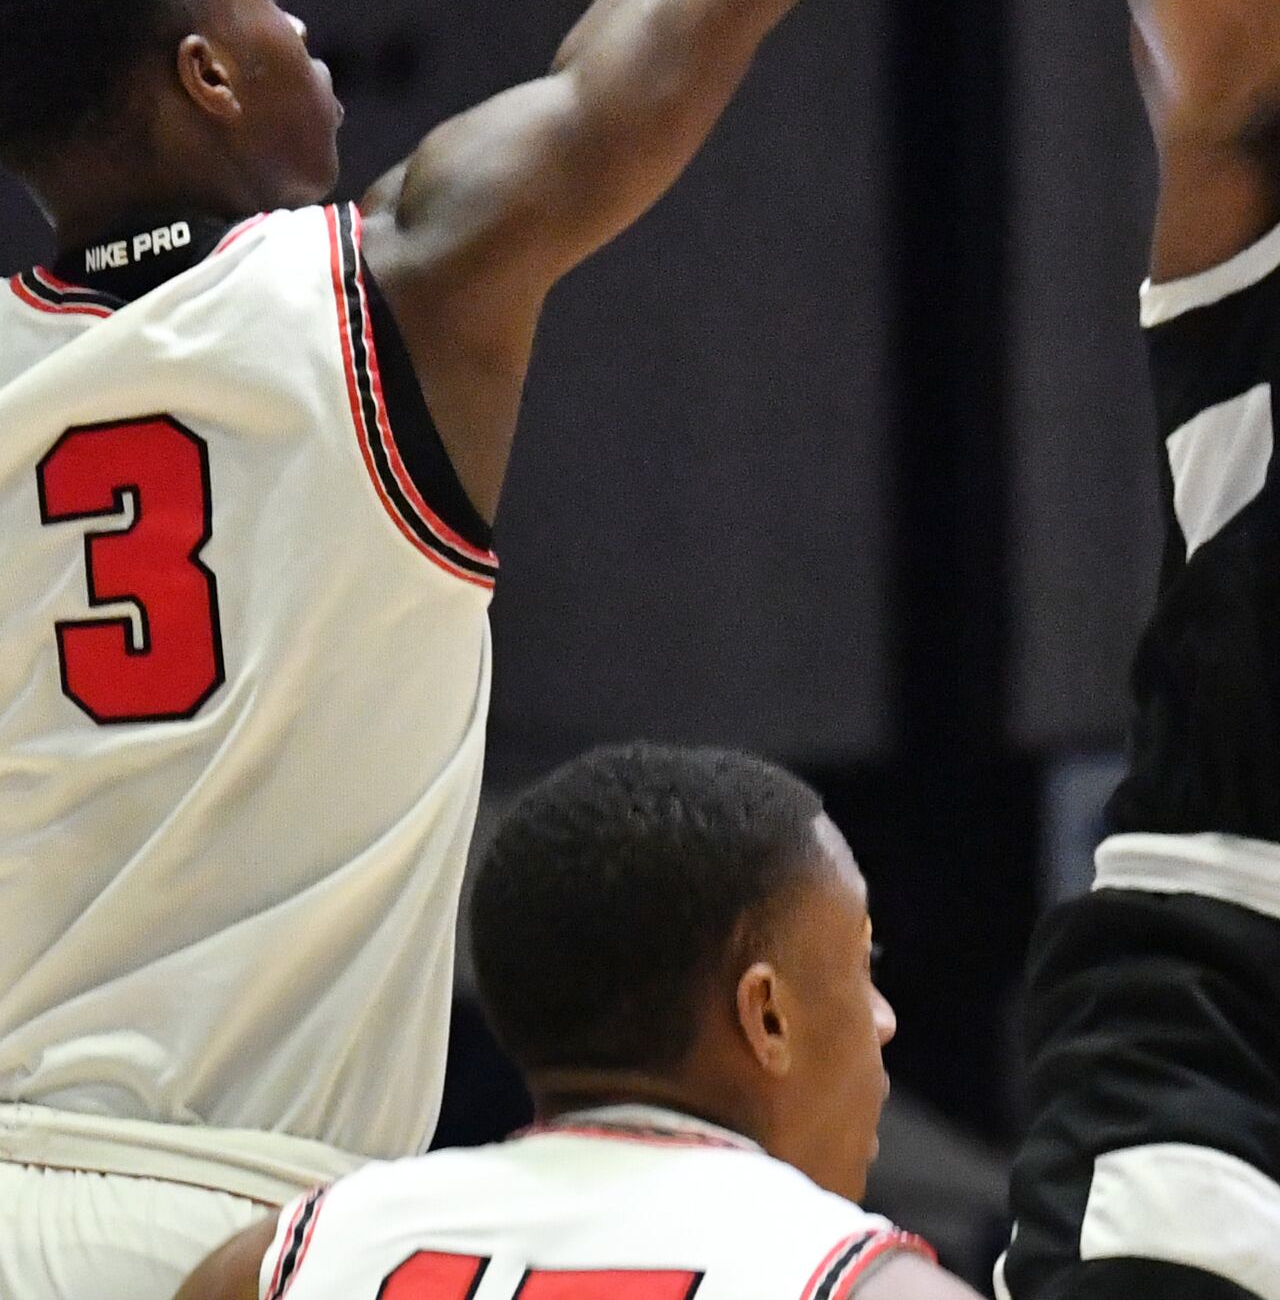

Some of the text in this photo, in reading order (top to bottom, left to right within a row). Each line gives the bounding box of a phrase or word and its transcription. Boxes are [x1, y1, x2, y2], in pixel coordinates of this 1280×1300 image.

[85, 221, 191, 274] NIKE PRO
[35, 412, 226, 726] 3
